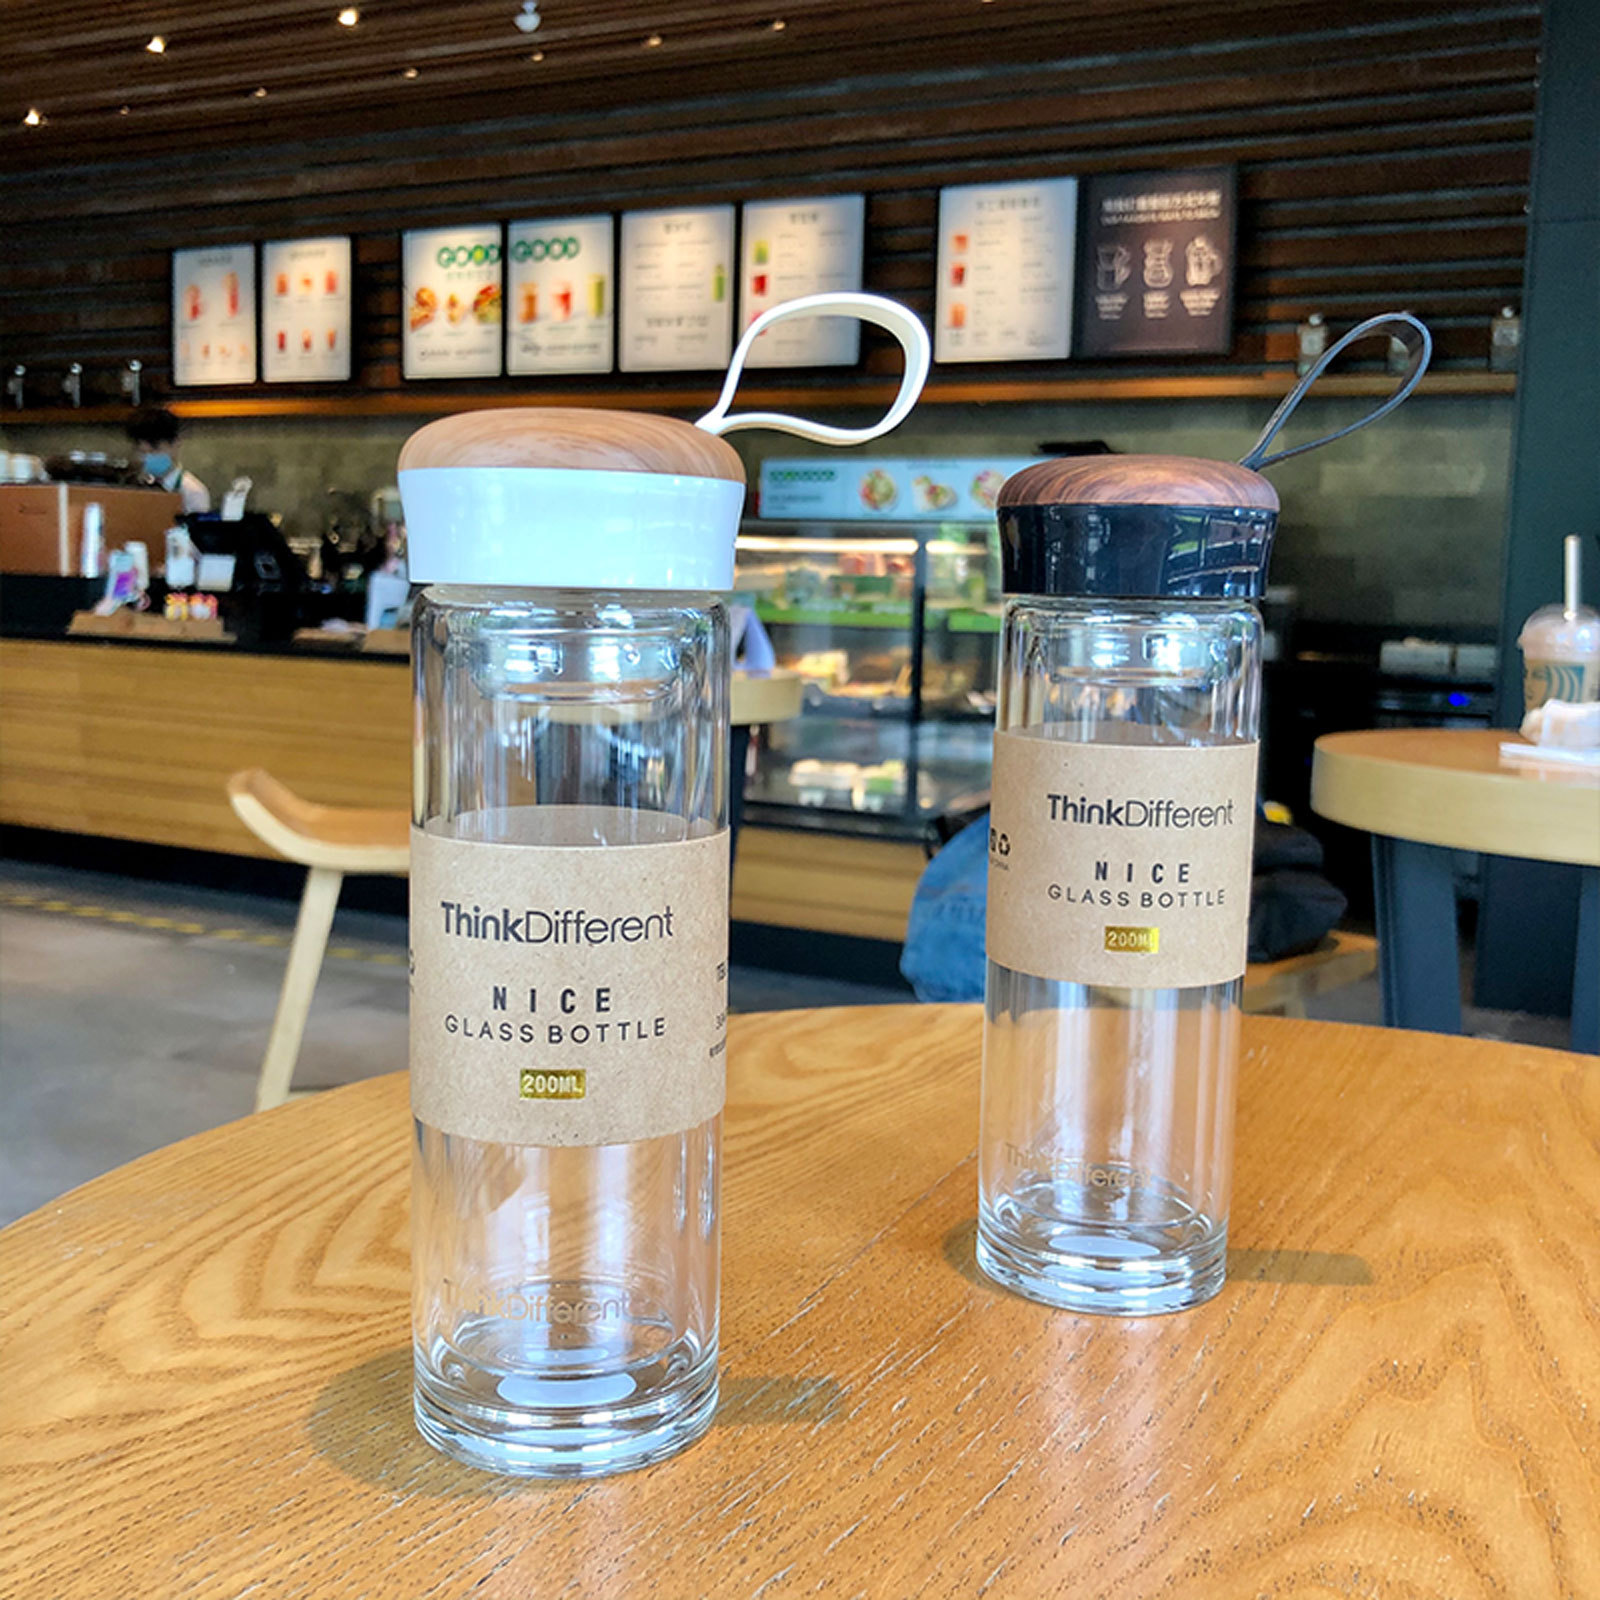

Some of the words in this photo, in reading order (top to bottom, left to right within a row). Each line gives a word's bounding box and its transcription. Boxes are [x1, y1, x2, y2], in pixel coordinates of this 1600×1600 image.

[511, 237, 580, 262] GOOD
[1047, 794, 1233, 828] ThinkDifferent
[1095, 861, 1190, 883] NICE
[1048, 884, 1129, 907] GLASS
[1141, 889, 1225, 909] BOTTLE
[440, 901, 673, 944] ThinkDifferent
[492, 986, 611, 1014] NICE
[444, 1014, 534, 1043] GLASS
[548, 1017, 666, 1044] BOTTLE
[523, 1074, 583, 1094] 200ML
